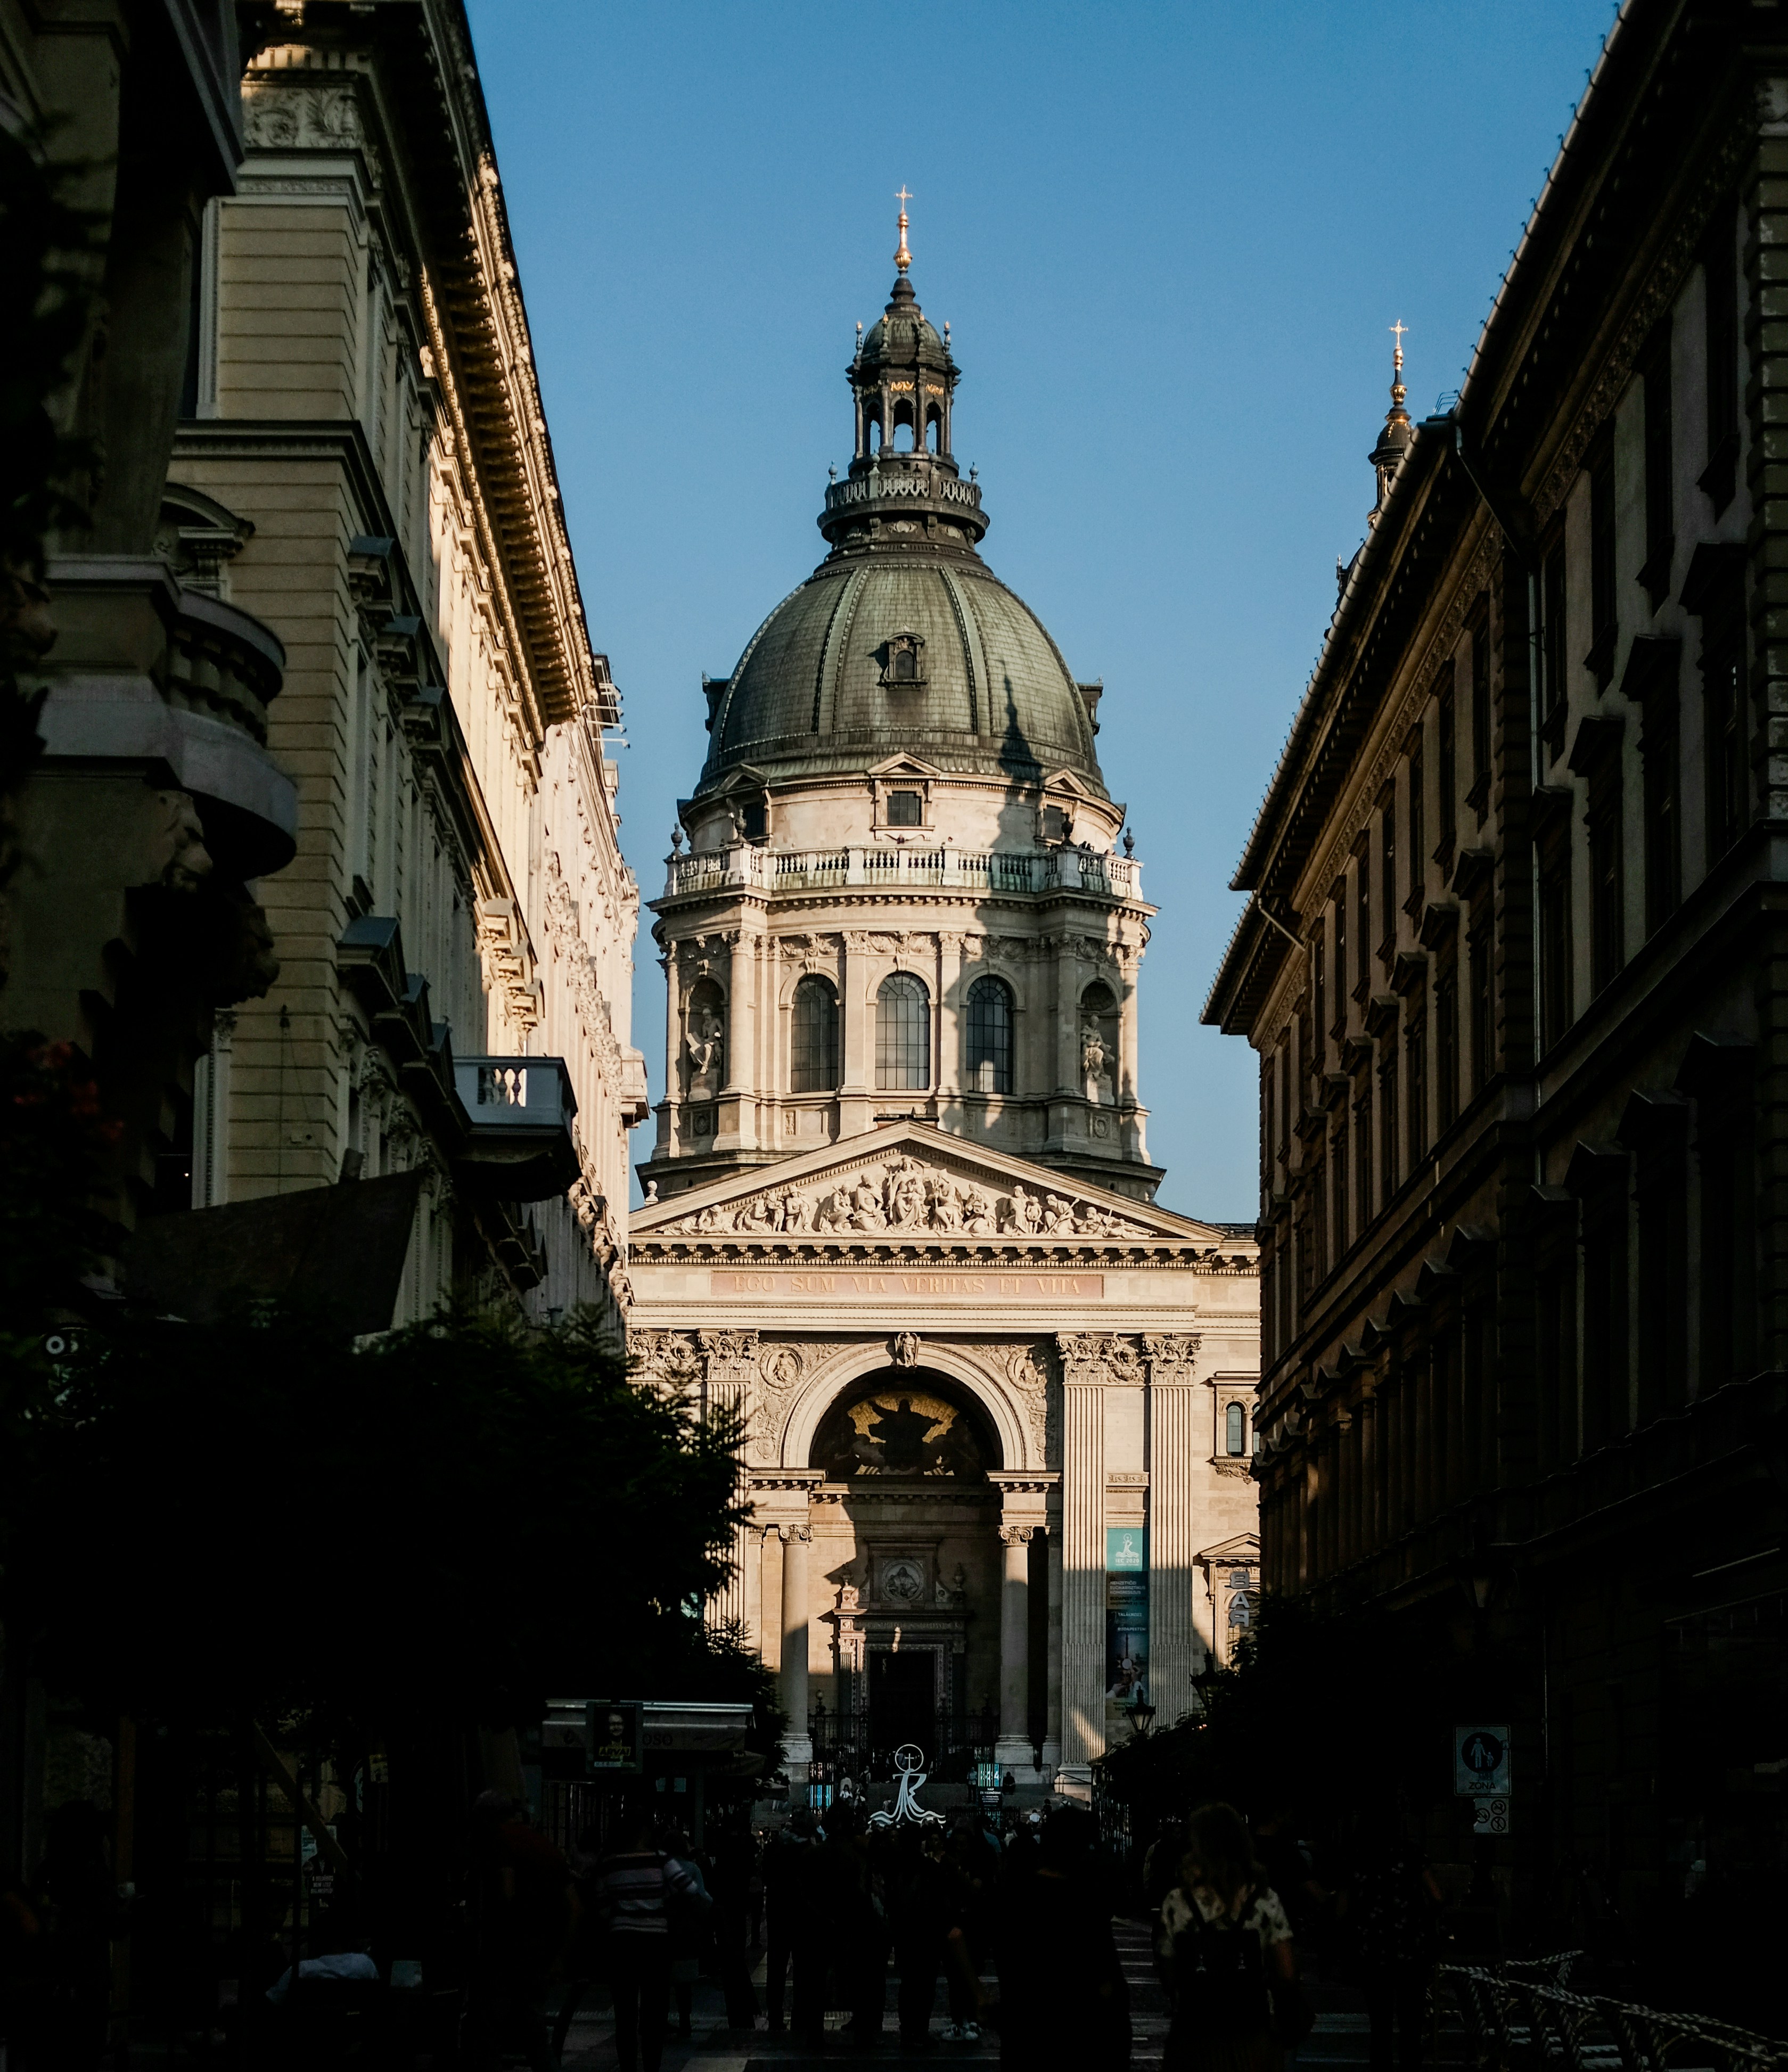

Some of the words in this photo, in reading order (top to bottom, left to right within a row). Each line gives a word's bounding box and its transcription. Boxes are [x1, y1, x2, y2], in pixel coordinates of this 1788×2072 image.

[734, 1275, 776, 1292] EGO
[791, 1276, 835, 1293] SUM
[851, 1277, 889, 1293] VIA
[901, 1277, 986, 1294] VERITAS
[999, 1278, 1025, 1294] ET
[1036, 1278, 1081, 1295] VITA
